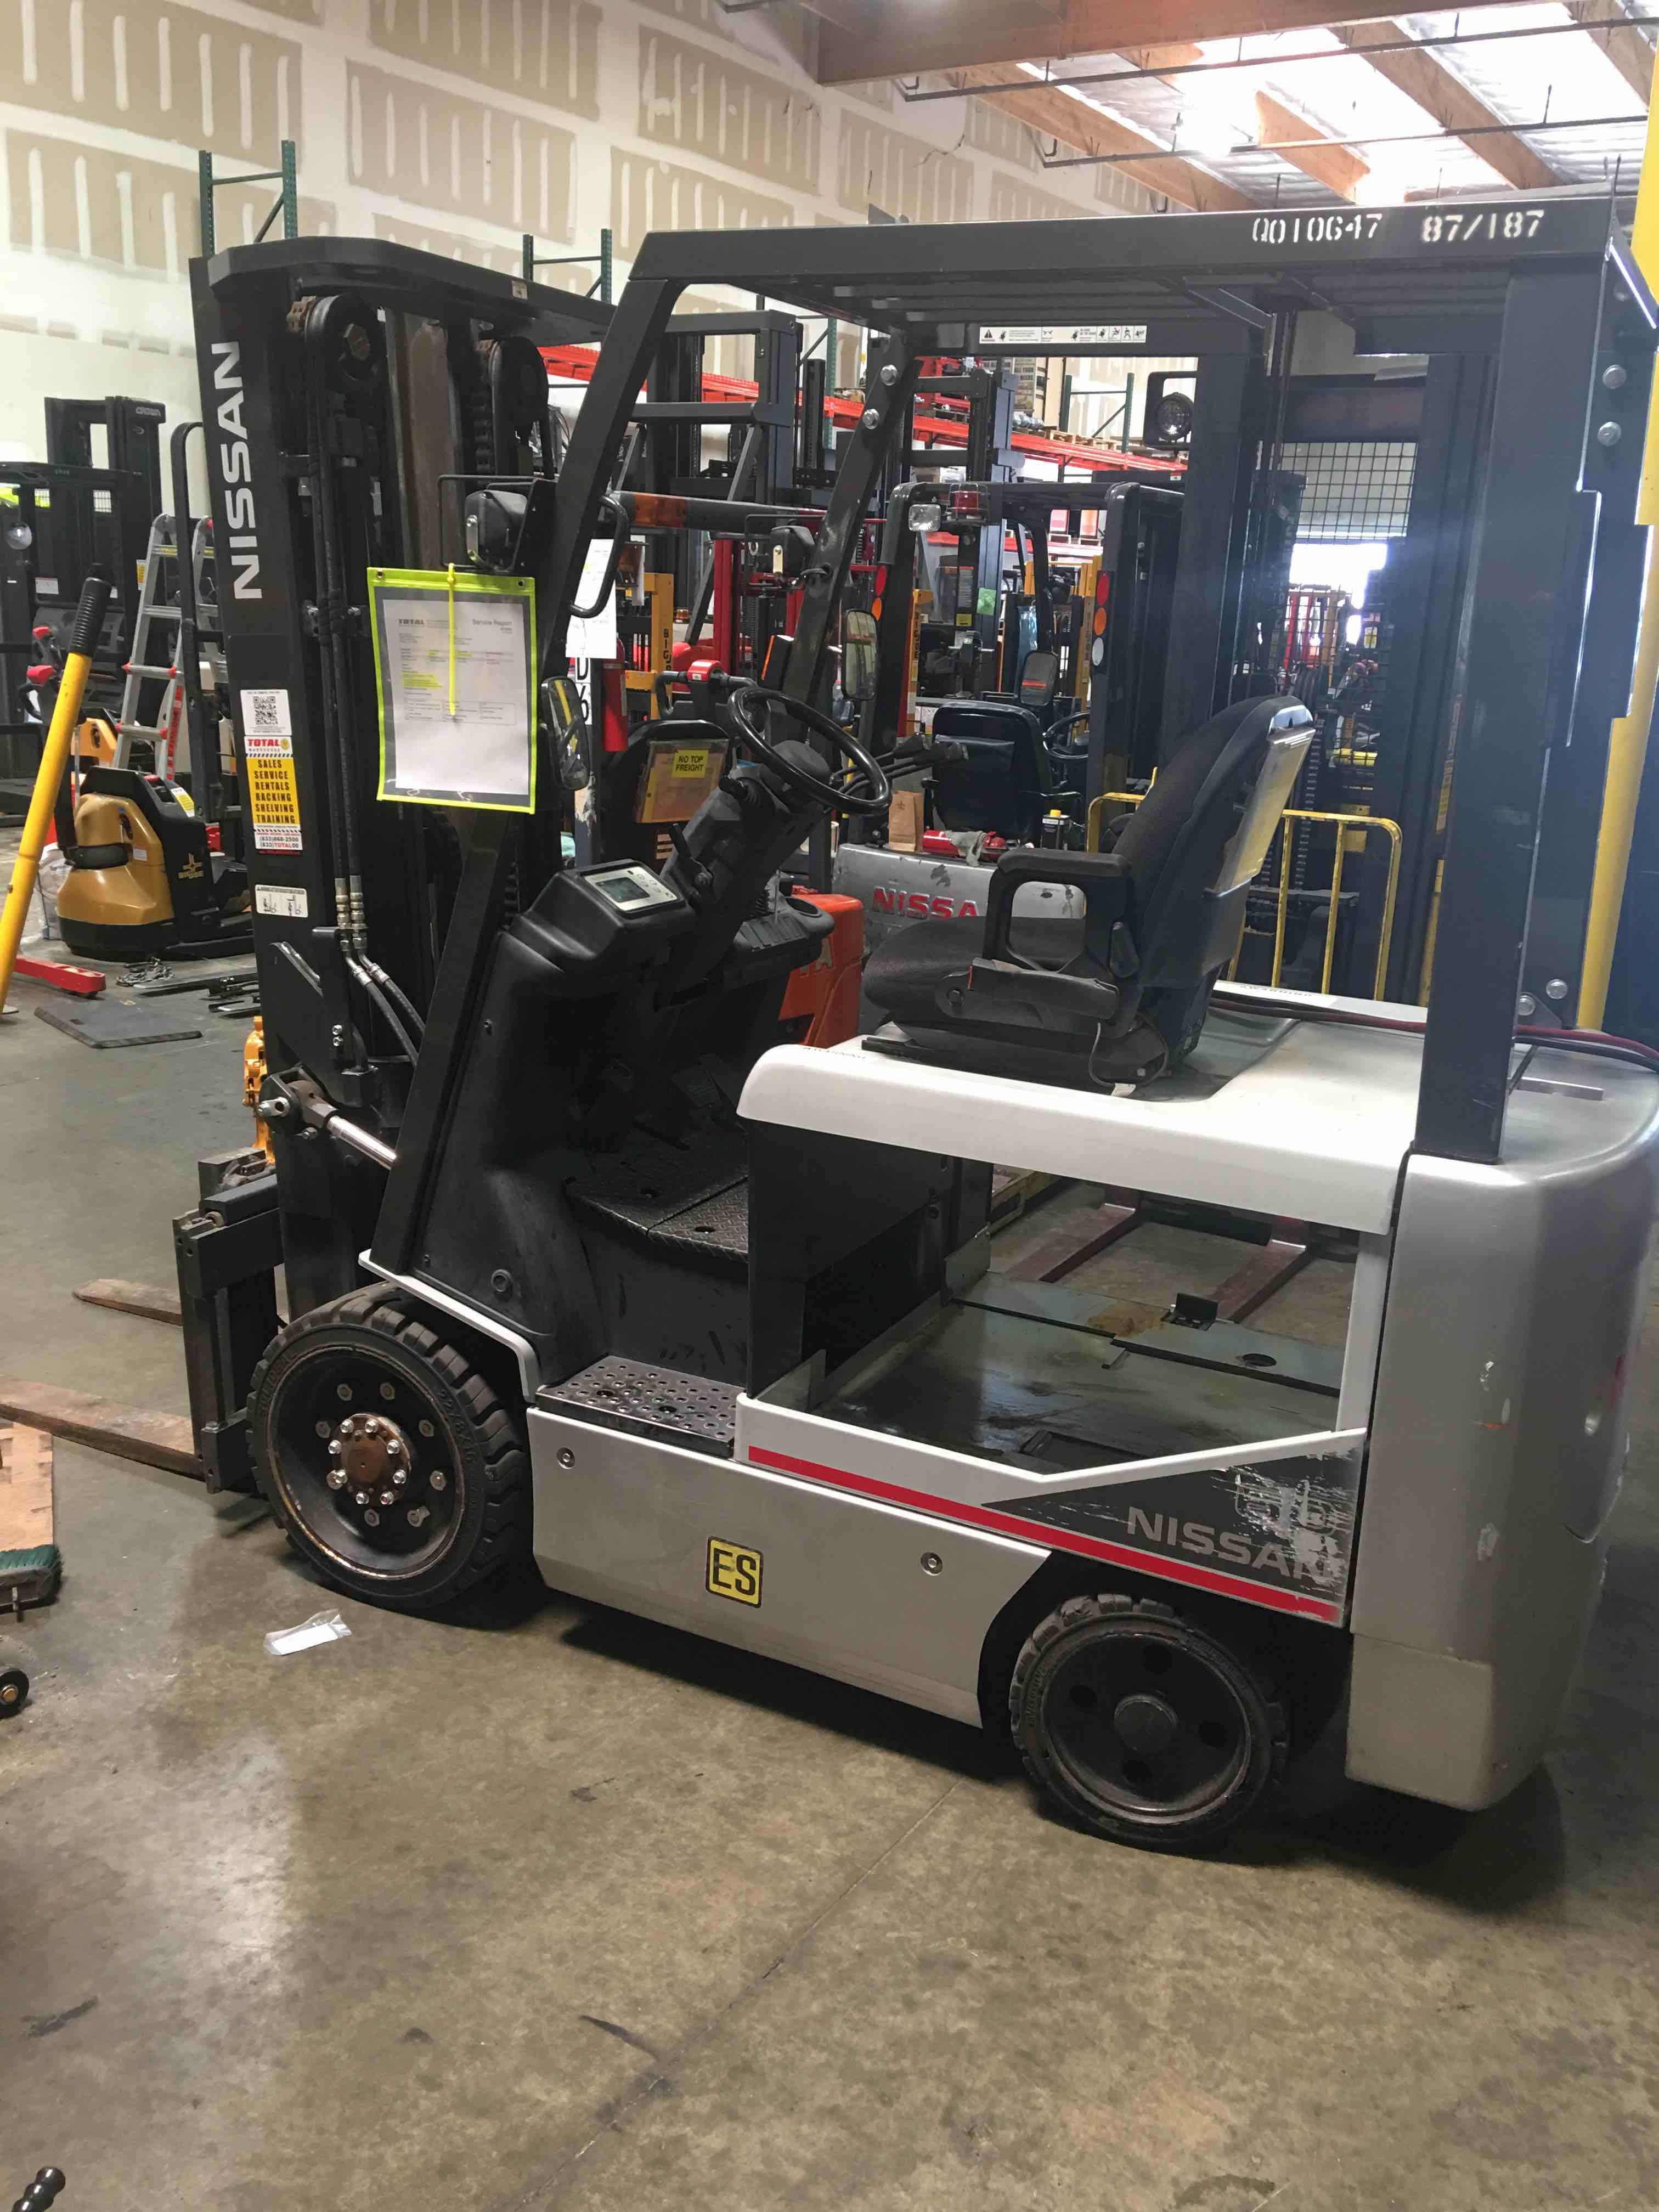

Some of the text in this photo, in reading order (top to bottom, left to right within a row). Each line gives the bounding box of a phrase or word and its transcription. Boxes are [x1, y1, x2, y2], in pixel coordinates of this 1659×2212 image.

[1421, 210, 1544, 244] 87/187
[211, 341, 262, 600] NISSAN
[258, 760, 282, 768] SALES
[255, 771, 288, 779] SERVICE
[255, 782, 290, 790] RENTALS
[256, 793, 291, 802] RACKING
[255, 804, 294, 812] SHELVING
[257, 815, 295, 823] TRAINING
[712, 1548, 757, 1595] ES
